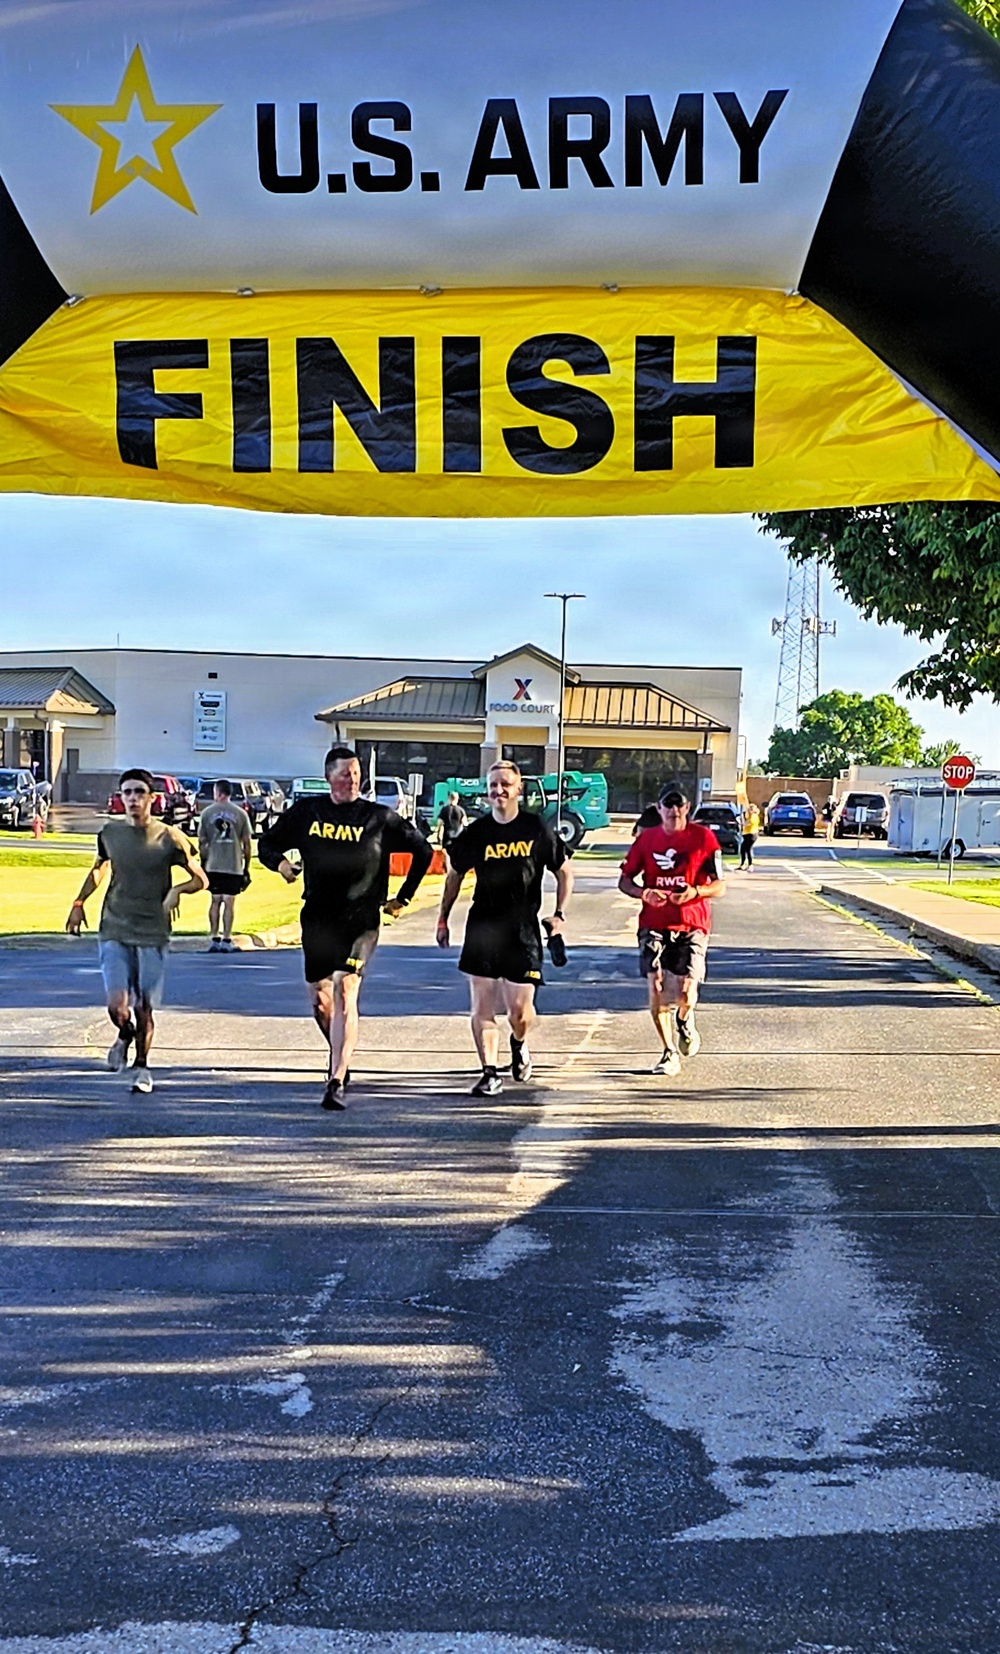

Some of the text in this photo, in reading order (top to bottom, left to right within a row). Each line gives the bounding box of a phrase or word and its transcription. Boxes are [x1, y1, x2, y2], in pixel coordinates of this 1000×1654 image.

[256, 89, 790, 194] U.S. ARMY
[113, 332, 758, 475] FINISH
[489, 703, 555, 714] FOOD COURT
[943, 764, 973, 779] STOP
[308, 820, 364, 843] ARMY
[484, 839, 535, 861] ARMY
